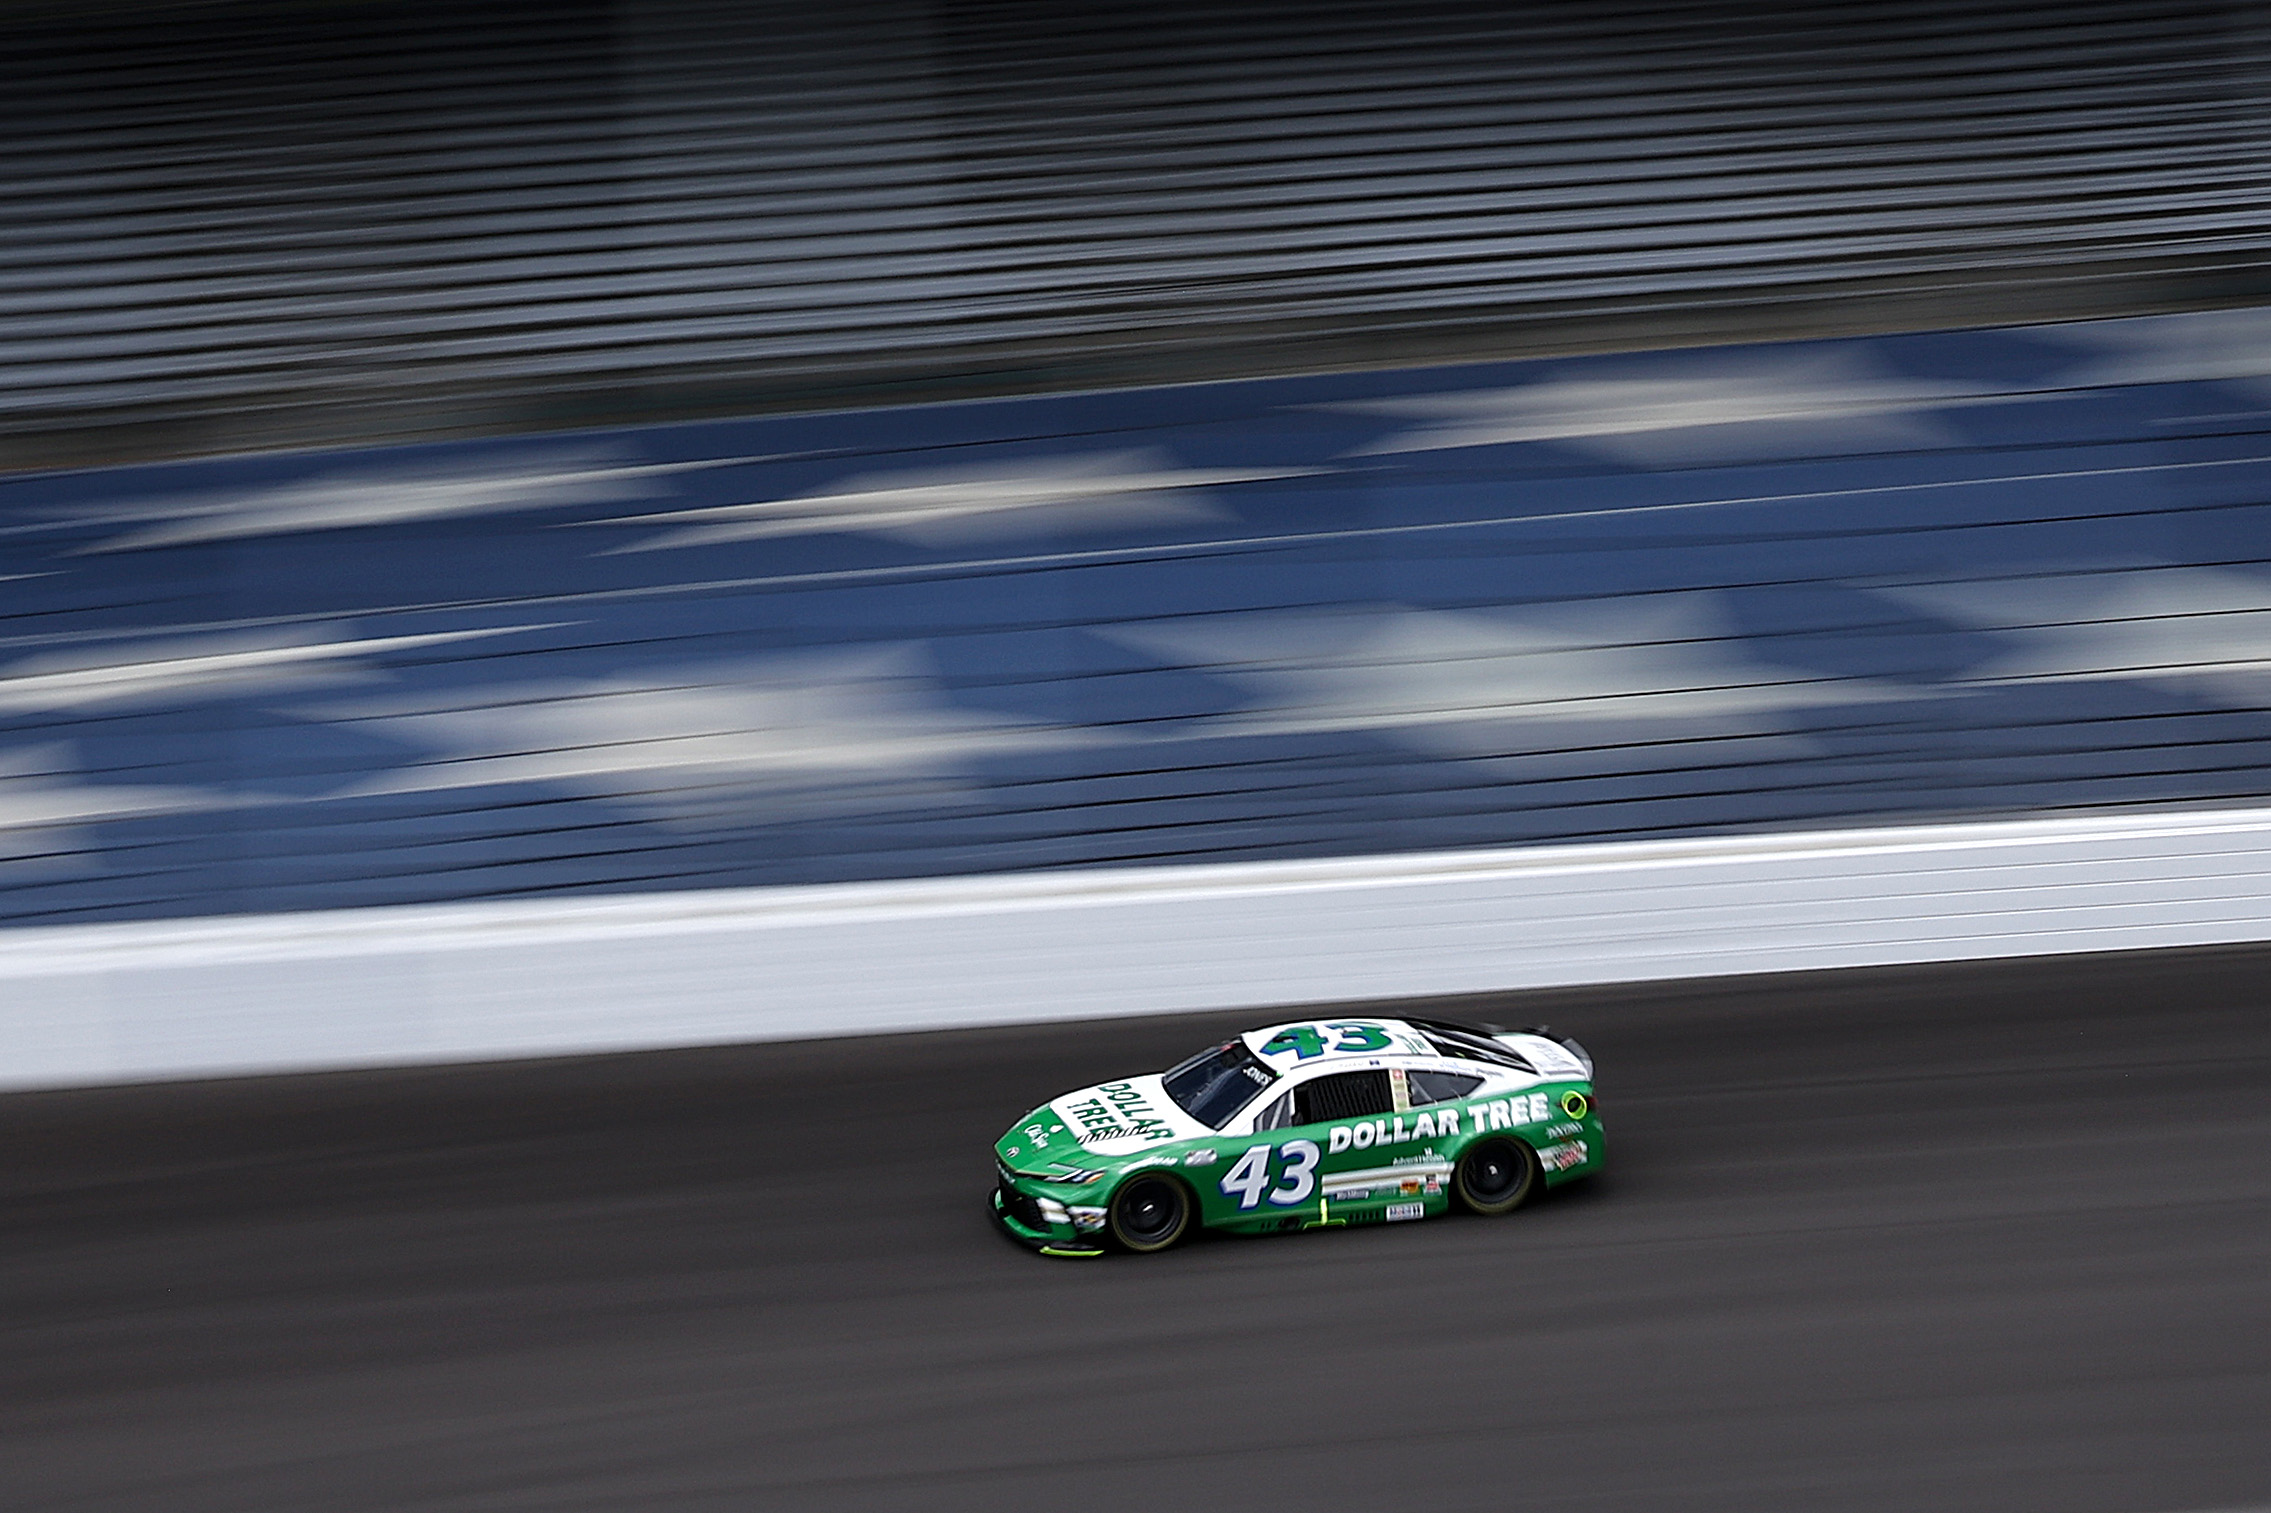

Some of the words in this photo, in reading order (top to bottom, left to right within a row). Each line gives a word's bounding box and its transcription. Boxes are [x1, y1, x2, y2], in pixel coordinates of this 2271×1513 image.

[1259, 1021, 1393, 1061] 43
[1066, 1098, 1124, 1139] TREE
[1098, 1083, 1176, 1141] DOLLAR
[1328, 1109, 1461, 1155] DOLLAR
[1467, 1092, 1550, 1134] TREE
[1219, 1138, 1321, 1210] 43
